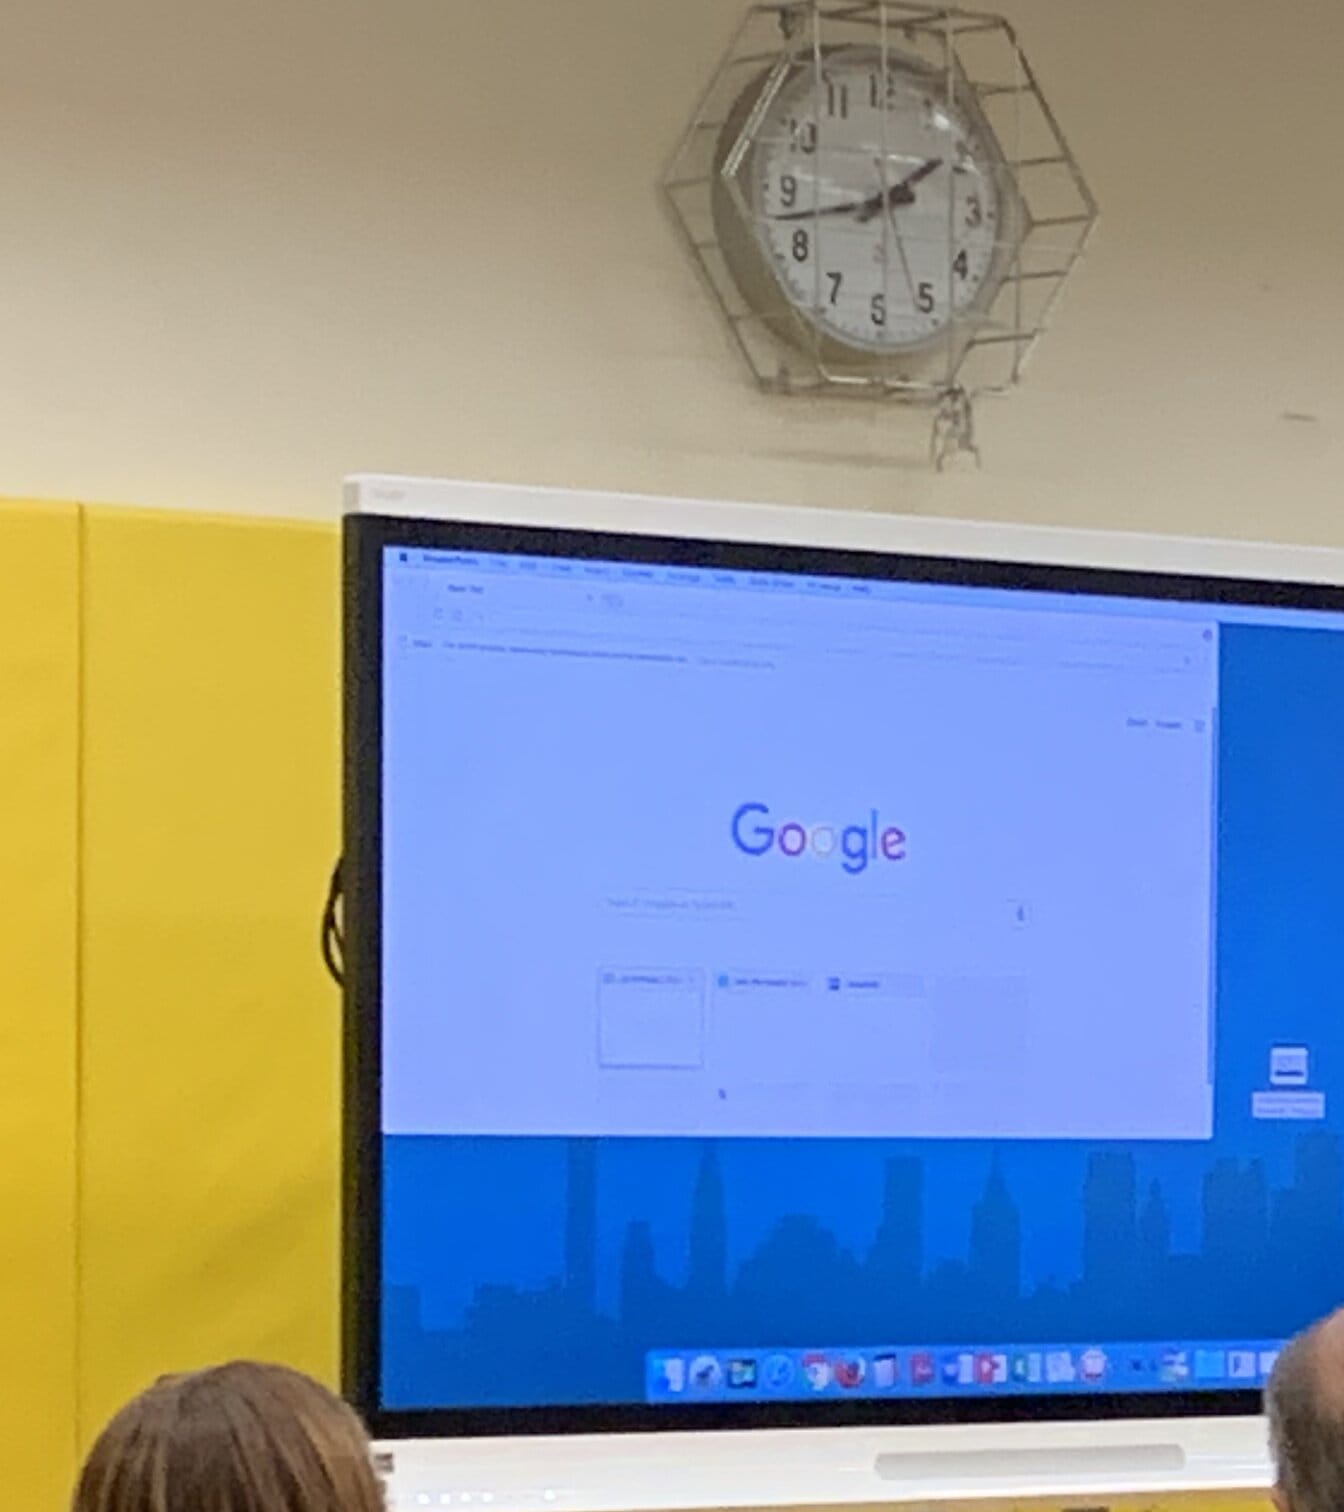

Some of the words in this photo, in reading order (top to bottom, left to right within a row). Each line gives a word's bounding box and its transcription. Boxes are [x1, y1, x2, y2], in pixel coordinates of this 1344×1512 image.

[822, 71, 848, 120] 11
[780, 174, 797, 208] 9
[964, 195, 982, 228] 3
[792, 228, 809, 263] 8
[953, 250, 969, 280] 4
[826, 271, 843, 305] 7
[915, 282, 935, 314] 5
[870, 293, 887, 327] 6
[731, 802, 907, 875] Google
